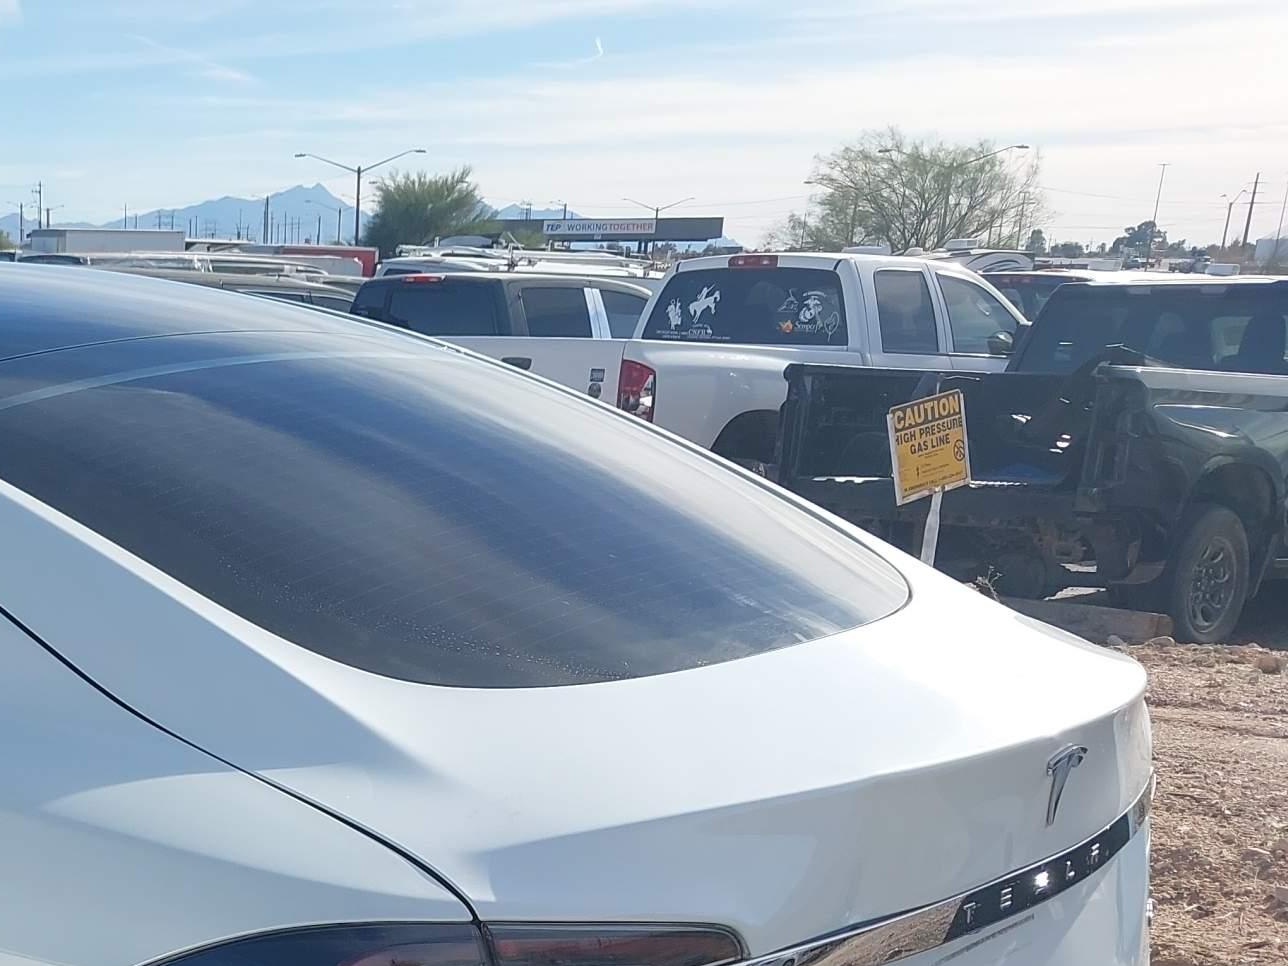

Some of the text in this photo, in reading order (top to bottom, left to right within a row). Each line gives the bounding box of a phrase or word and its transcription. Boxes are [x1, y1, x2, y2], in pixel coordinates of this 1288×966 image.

[545, 222, 654, 232] TEP WORKING TOGETHER
[894, 394, 960, 430] CAUTION
[895, 416, 963, 446] HIGH PRESSURE
[910, 441, 929, 455] GAS
[931, 433, 951, 449] LINE
